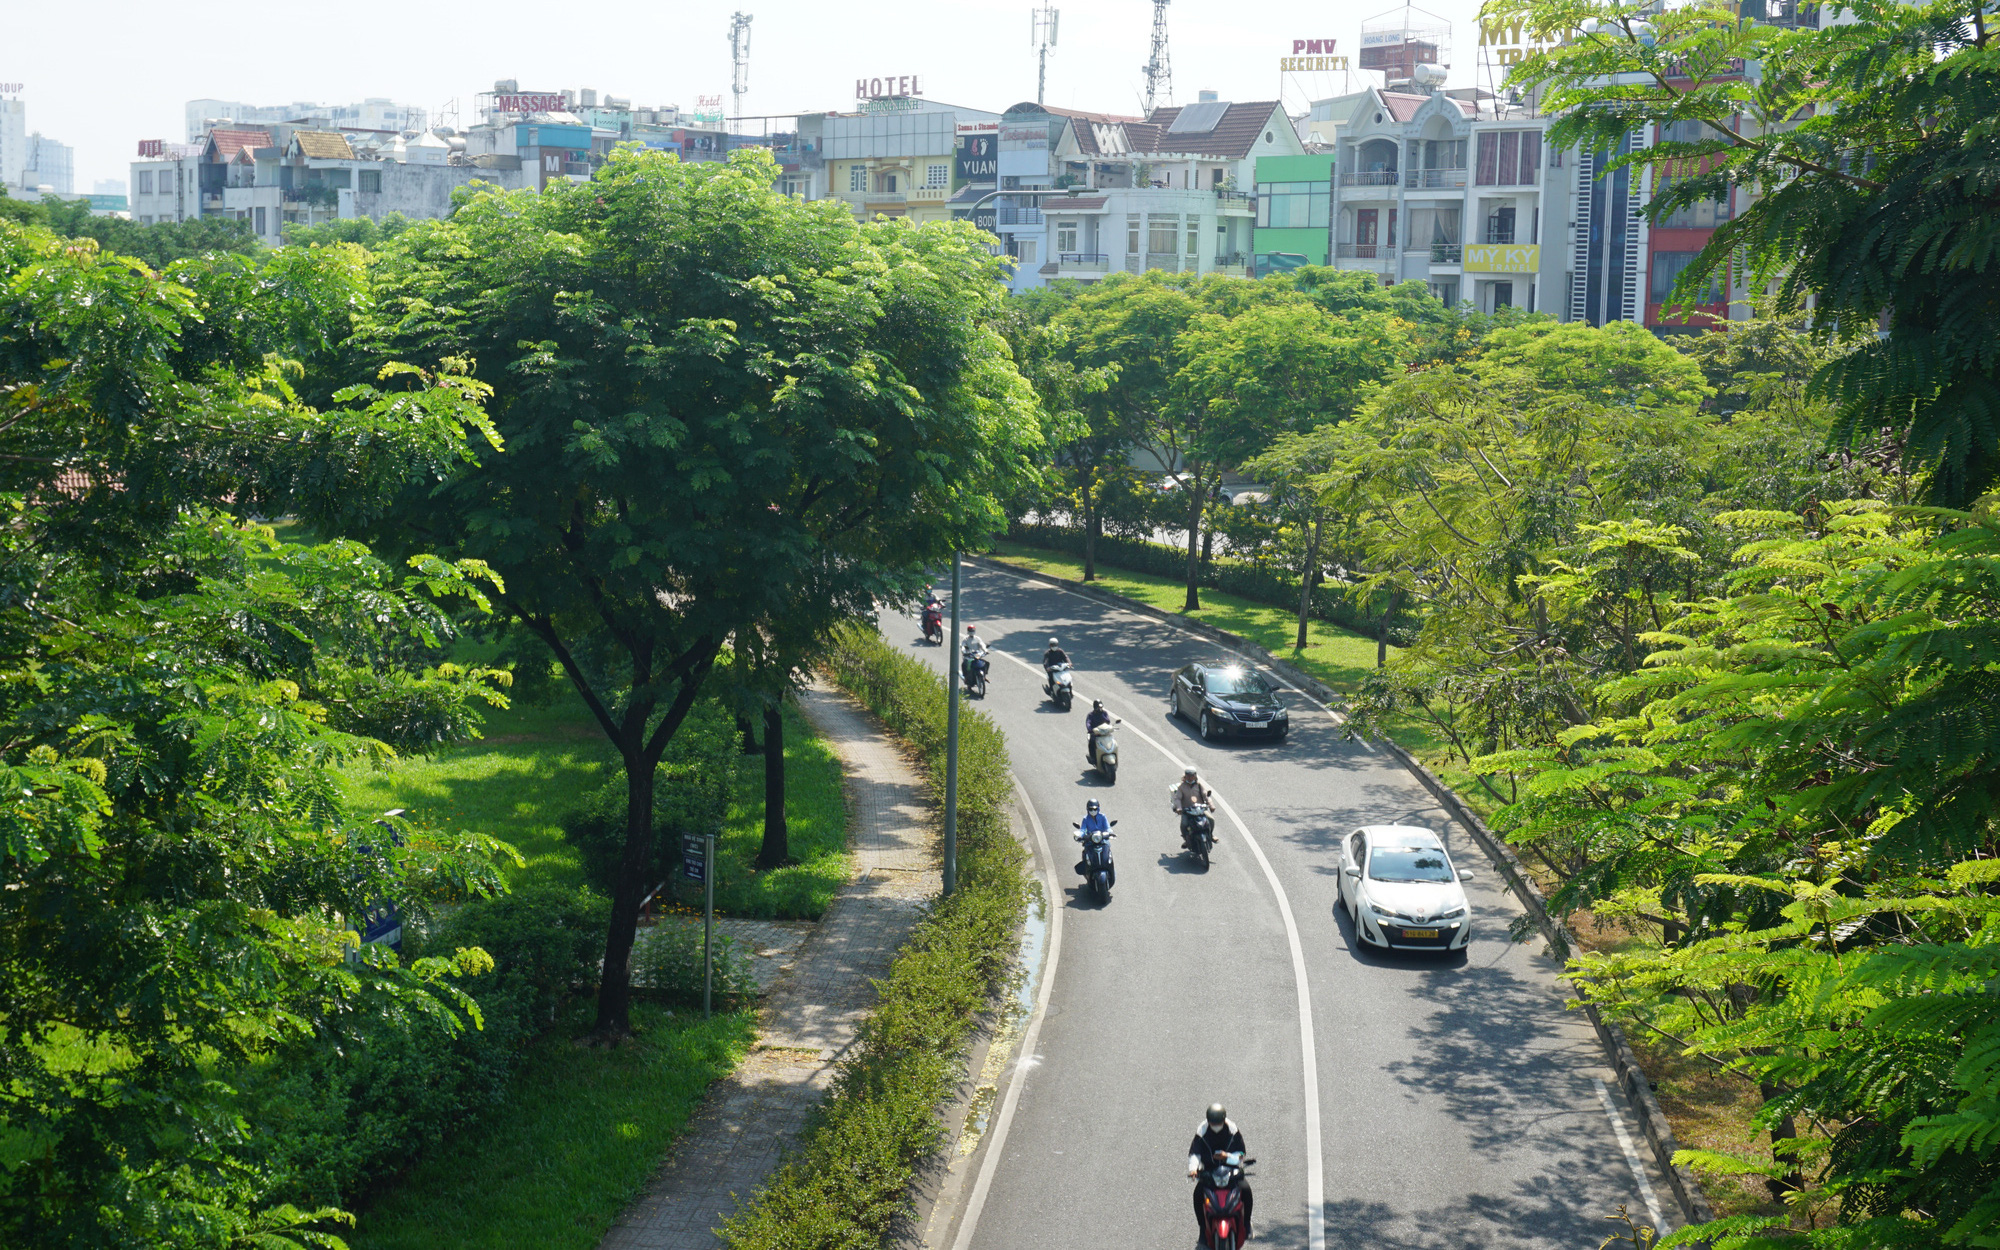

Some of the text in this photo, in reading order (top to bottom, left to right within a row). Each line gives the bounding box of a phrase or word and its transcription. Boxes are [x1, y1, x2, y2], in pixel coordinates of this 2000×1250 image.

[1293, 39, 1336, 54] PMV
[1281, 56, 1348, 71] SECURITY
[856, 75, 922, 99] HOTEL
[499, 95, 566, 112] MASSAGE
[546, 155, 560, 171] M
[963, 160, 996, 174] YUAN
[978, 215, 997, 227] BODY
[1489, 264, 1532, 272] TRAVEL
